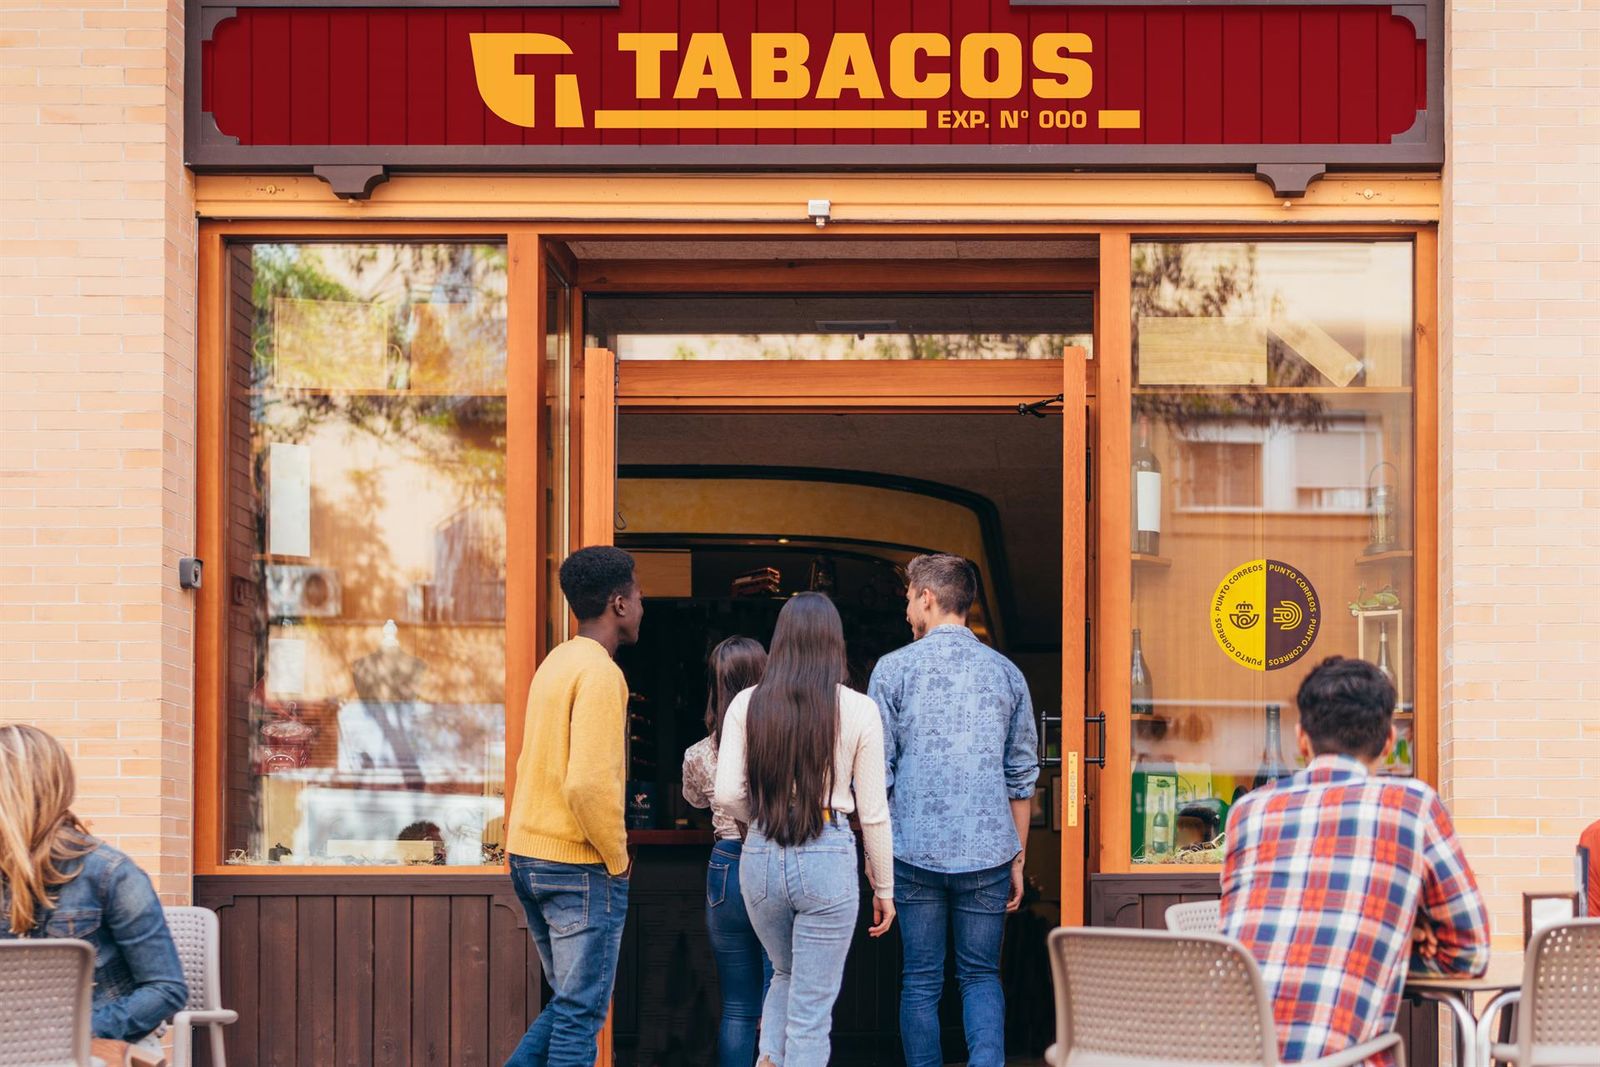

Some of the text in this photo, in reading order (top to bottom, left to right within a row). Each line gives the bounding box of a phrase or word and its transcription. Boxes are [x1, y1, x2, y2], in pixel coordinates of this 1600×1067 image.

[618, 32, 1093, 99] TABACOS
[937, 110, 990, 129] EXP.
[1039, 110, 1087, 129] 000
[1215, 564, 1263, 612] PUNTO CORREOS
[1269, 564, 1317, 613] PUNTO CORREOS
[1215, 618, 1262, 666] PUNTO CORREOS
[1268, 618, 1317, 666] PUNTO CORREOS
